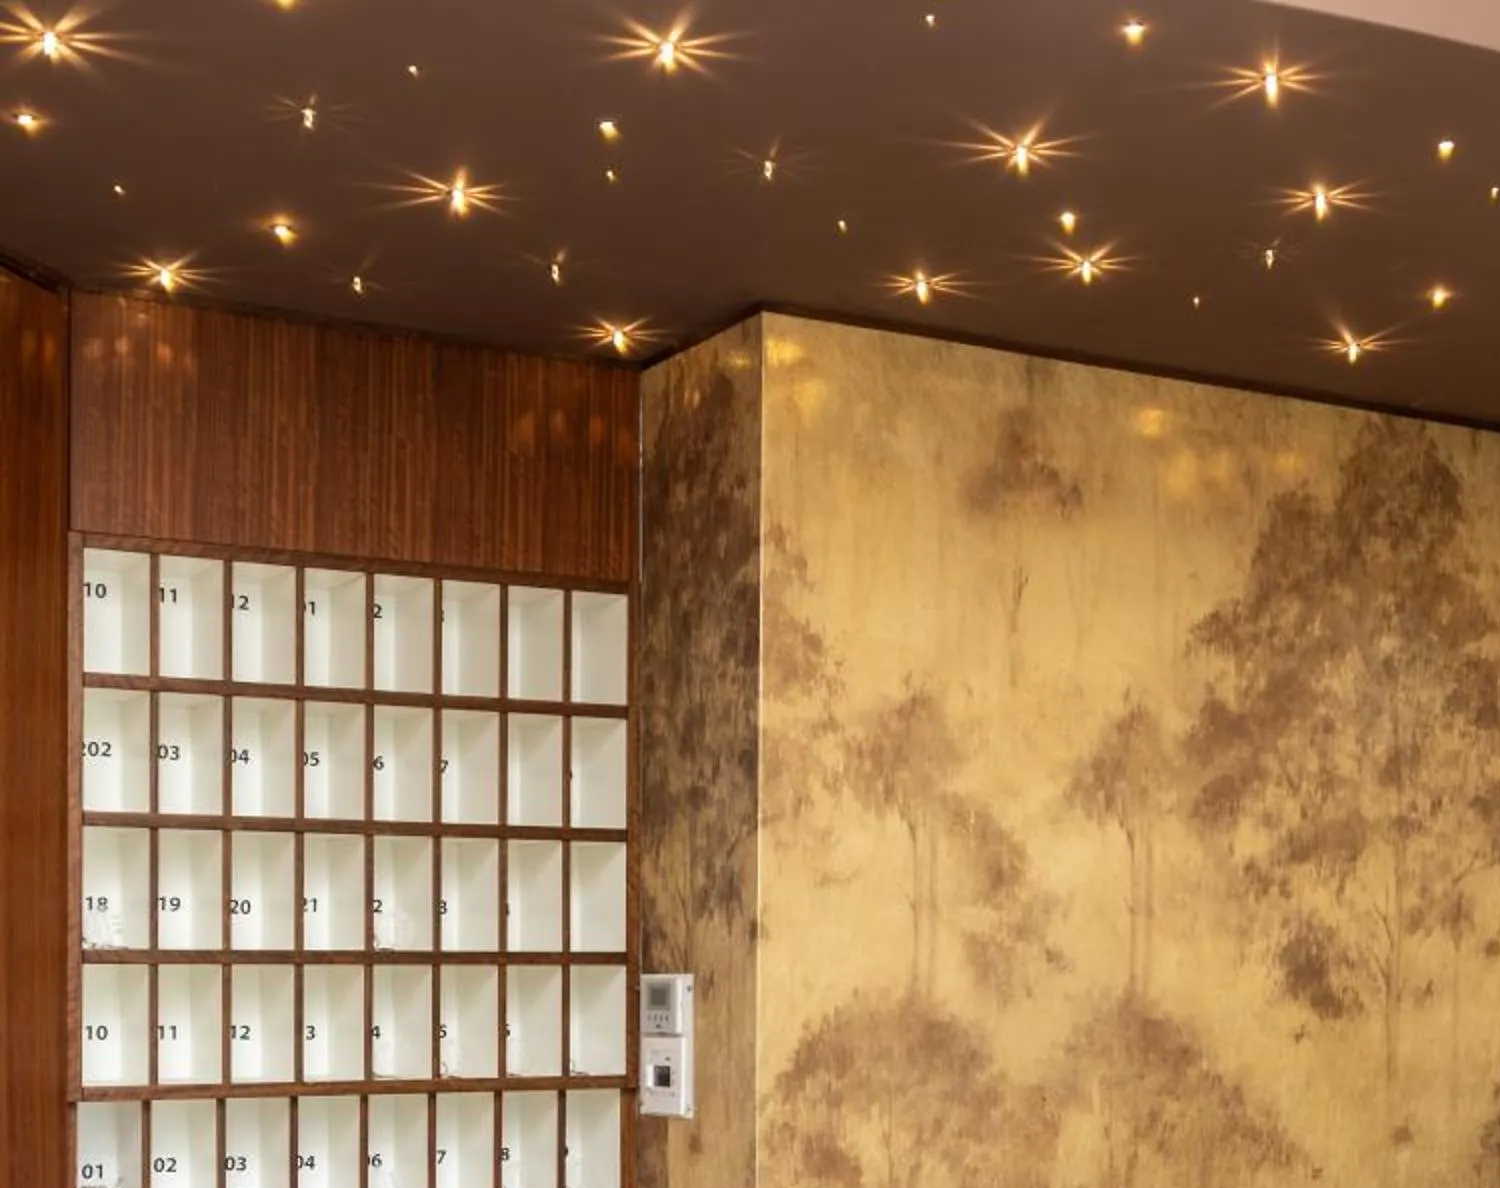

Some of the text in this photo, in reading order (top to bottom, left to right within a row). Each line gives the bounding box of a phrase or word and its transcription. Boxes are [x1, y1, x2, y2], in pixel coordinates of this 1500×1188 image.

[84, 582, 107, 599] 10
[85, 897, 109, 912] 18
[157, 897, 181, 912] 19
[85, 1025, 109, 1040] 10
[154, 1157, 177, 1173] 02
[225, 1156, 247, 1171] 03
[82, 1164, 104, 1179] 01
